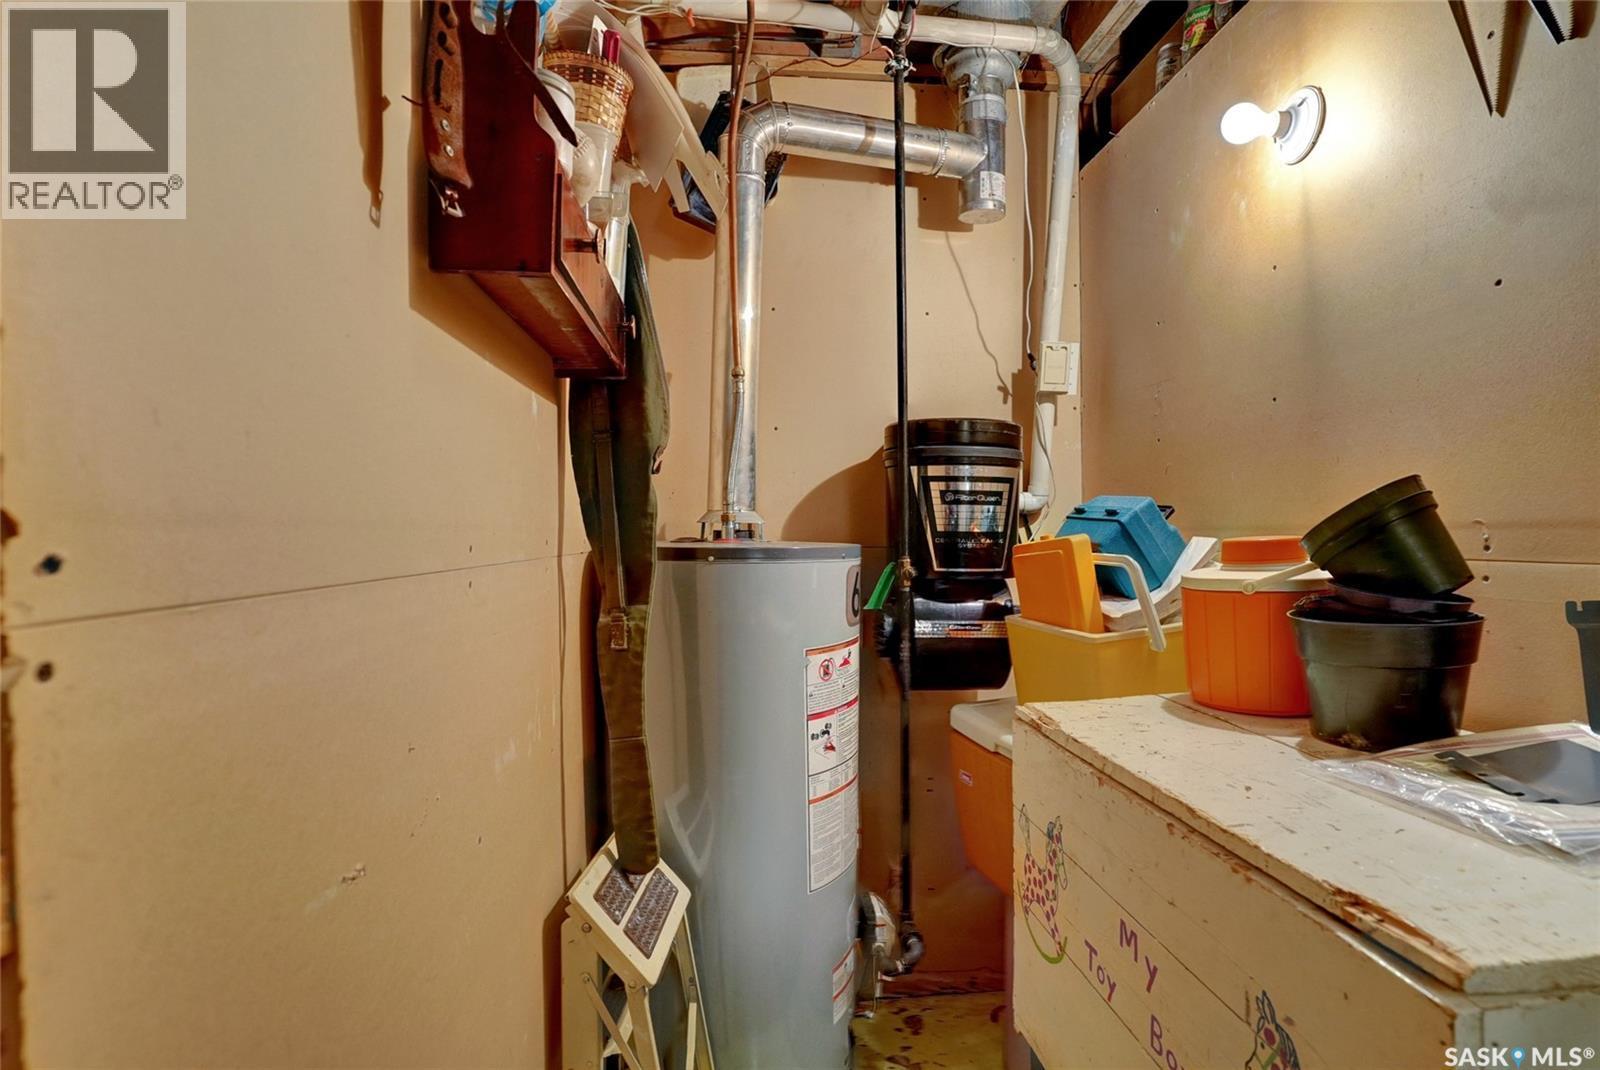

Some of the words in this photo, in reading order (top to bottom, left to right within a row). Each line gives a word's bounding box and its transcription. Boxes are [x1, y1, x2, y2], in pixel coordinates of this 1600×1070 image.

[1084, 939, 1117, 1003] Toy
[1151, 1014, 1185, 1070] Bo
[1119, 918, 1159, 993] My
